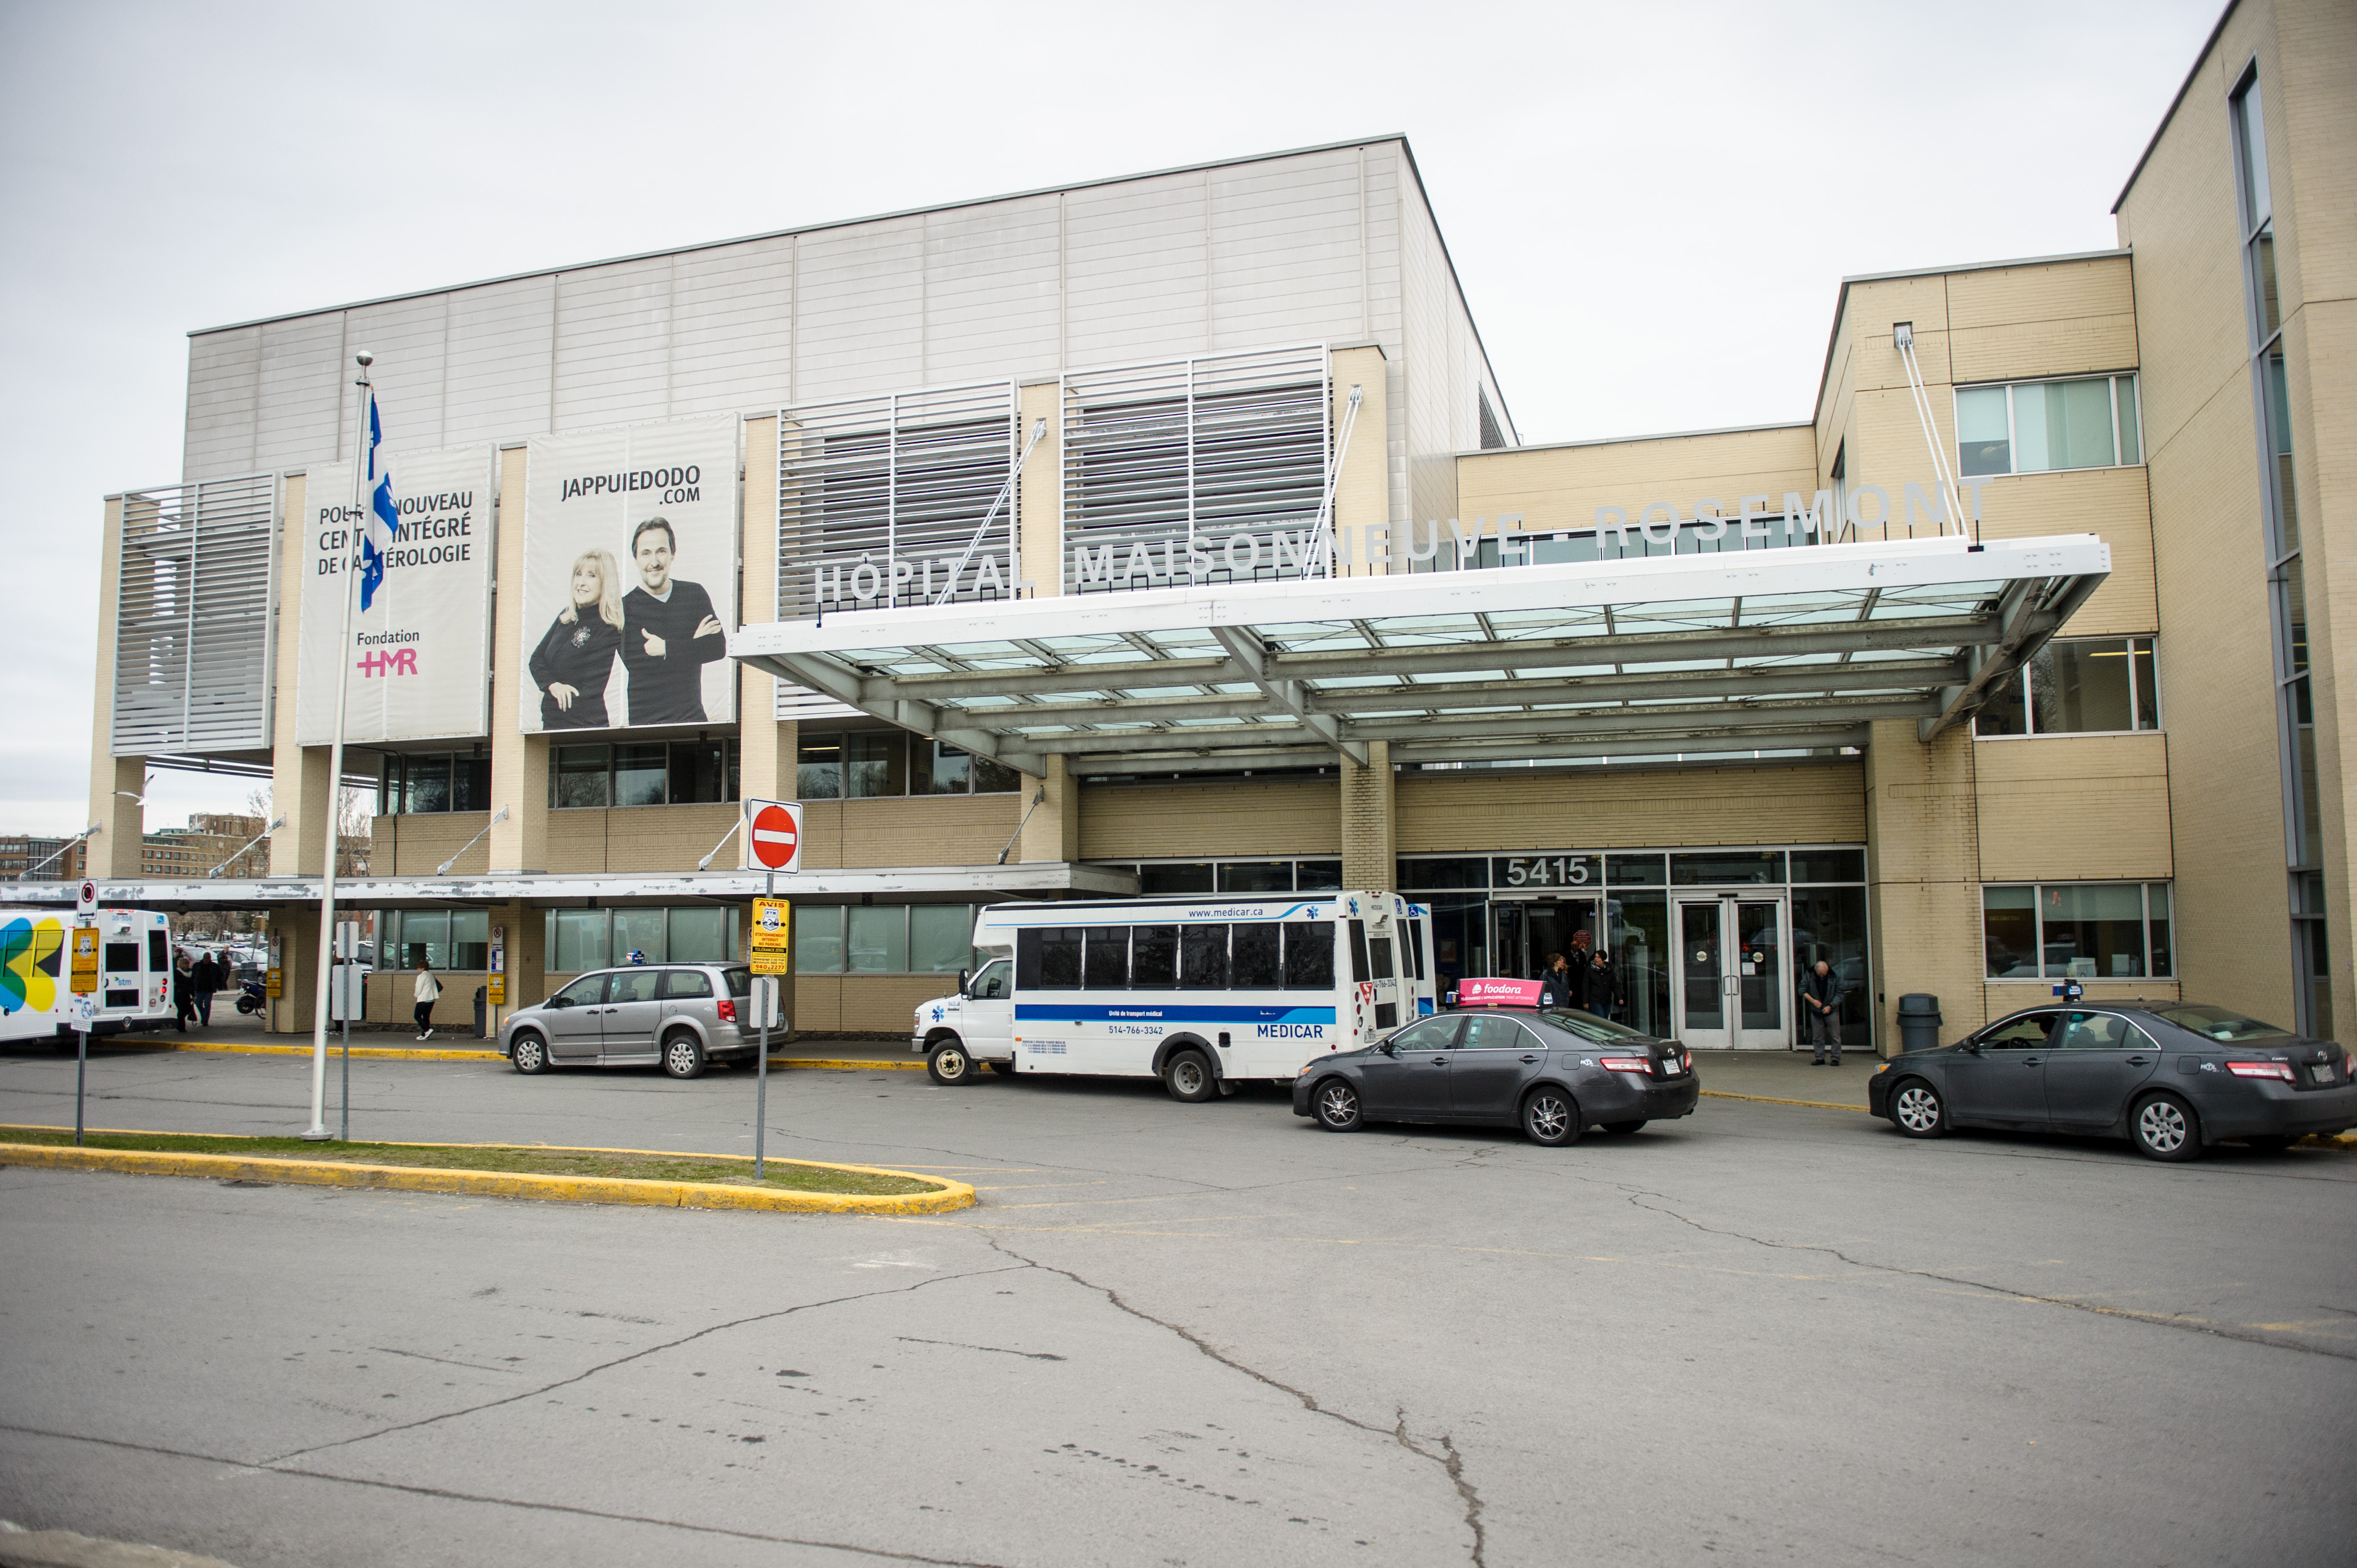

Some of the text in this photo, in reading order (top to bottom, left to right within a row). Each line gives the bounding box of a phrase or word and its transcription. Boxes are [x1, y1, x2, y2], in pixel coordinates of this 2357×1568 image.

[562, 465, 700, 502] JAPPUIEDODO
[659, 487, 700, 505] .COM
[320, 511, 471, 551] CENT INTÉGRÉ
[815, 552, 1036, 603] HÔPITAL
[1075, 513, 1527, 584] MAISONNEUVE
[1595, 477, 1994, 548] ROSEMONT
[318, 557, 337, 575] DE
[357, 629, 419, 645] Fondation
[357, 648, 418, 678] HMR
[1507, 858, 1588, 884] 5415
[1189, 908, 1263, 917] www.medicar.ca
[118, 977, 132, 986] stm
[1484, 984, 1521, 994] foodora
[1109, 1026, 1163, 1034] 514-766-3342
[1257, 1025, 1323, 1038] MEDICAR
